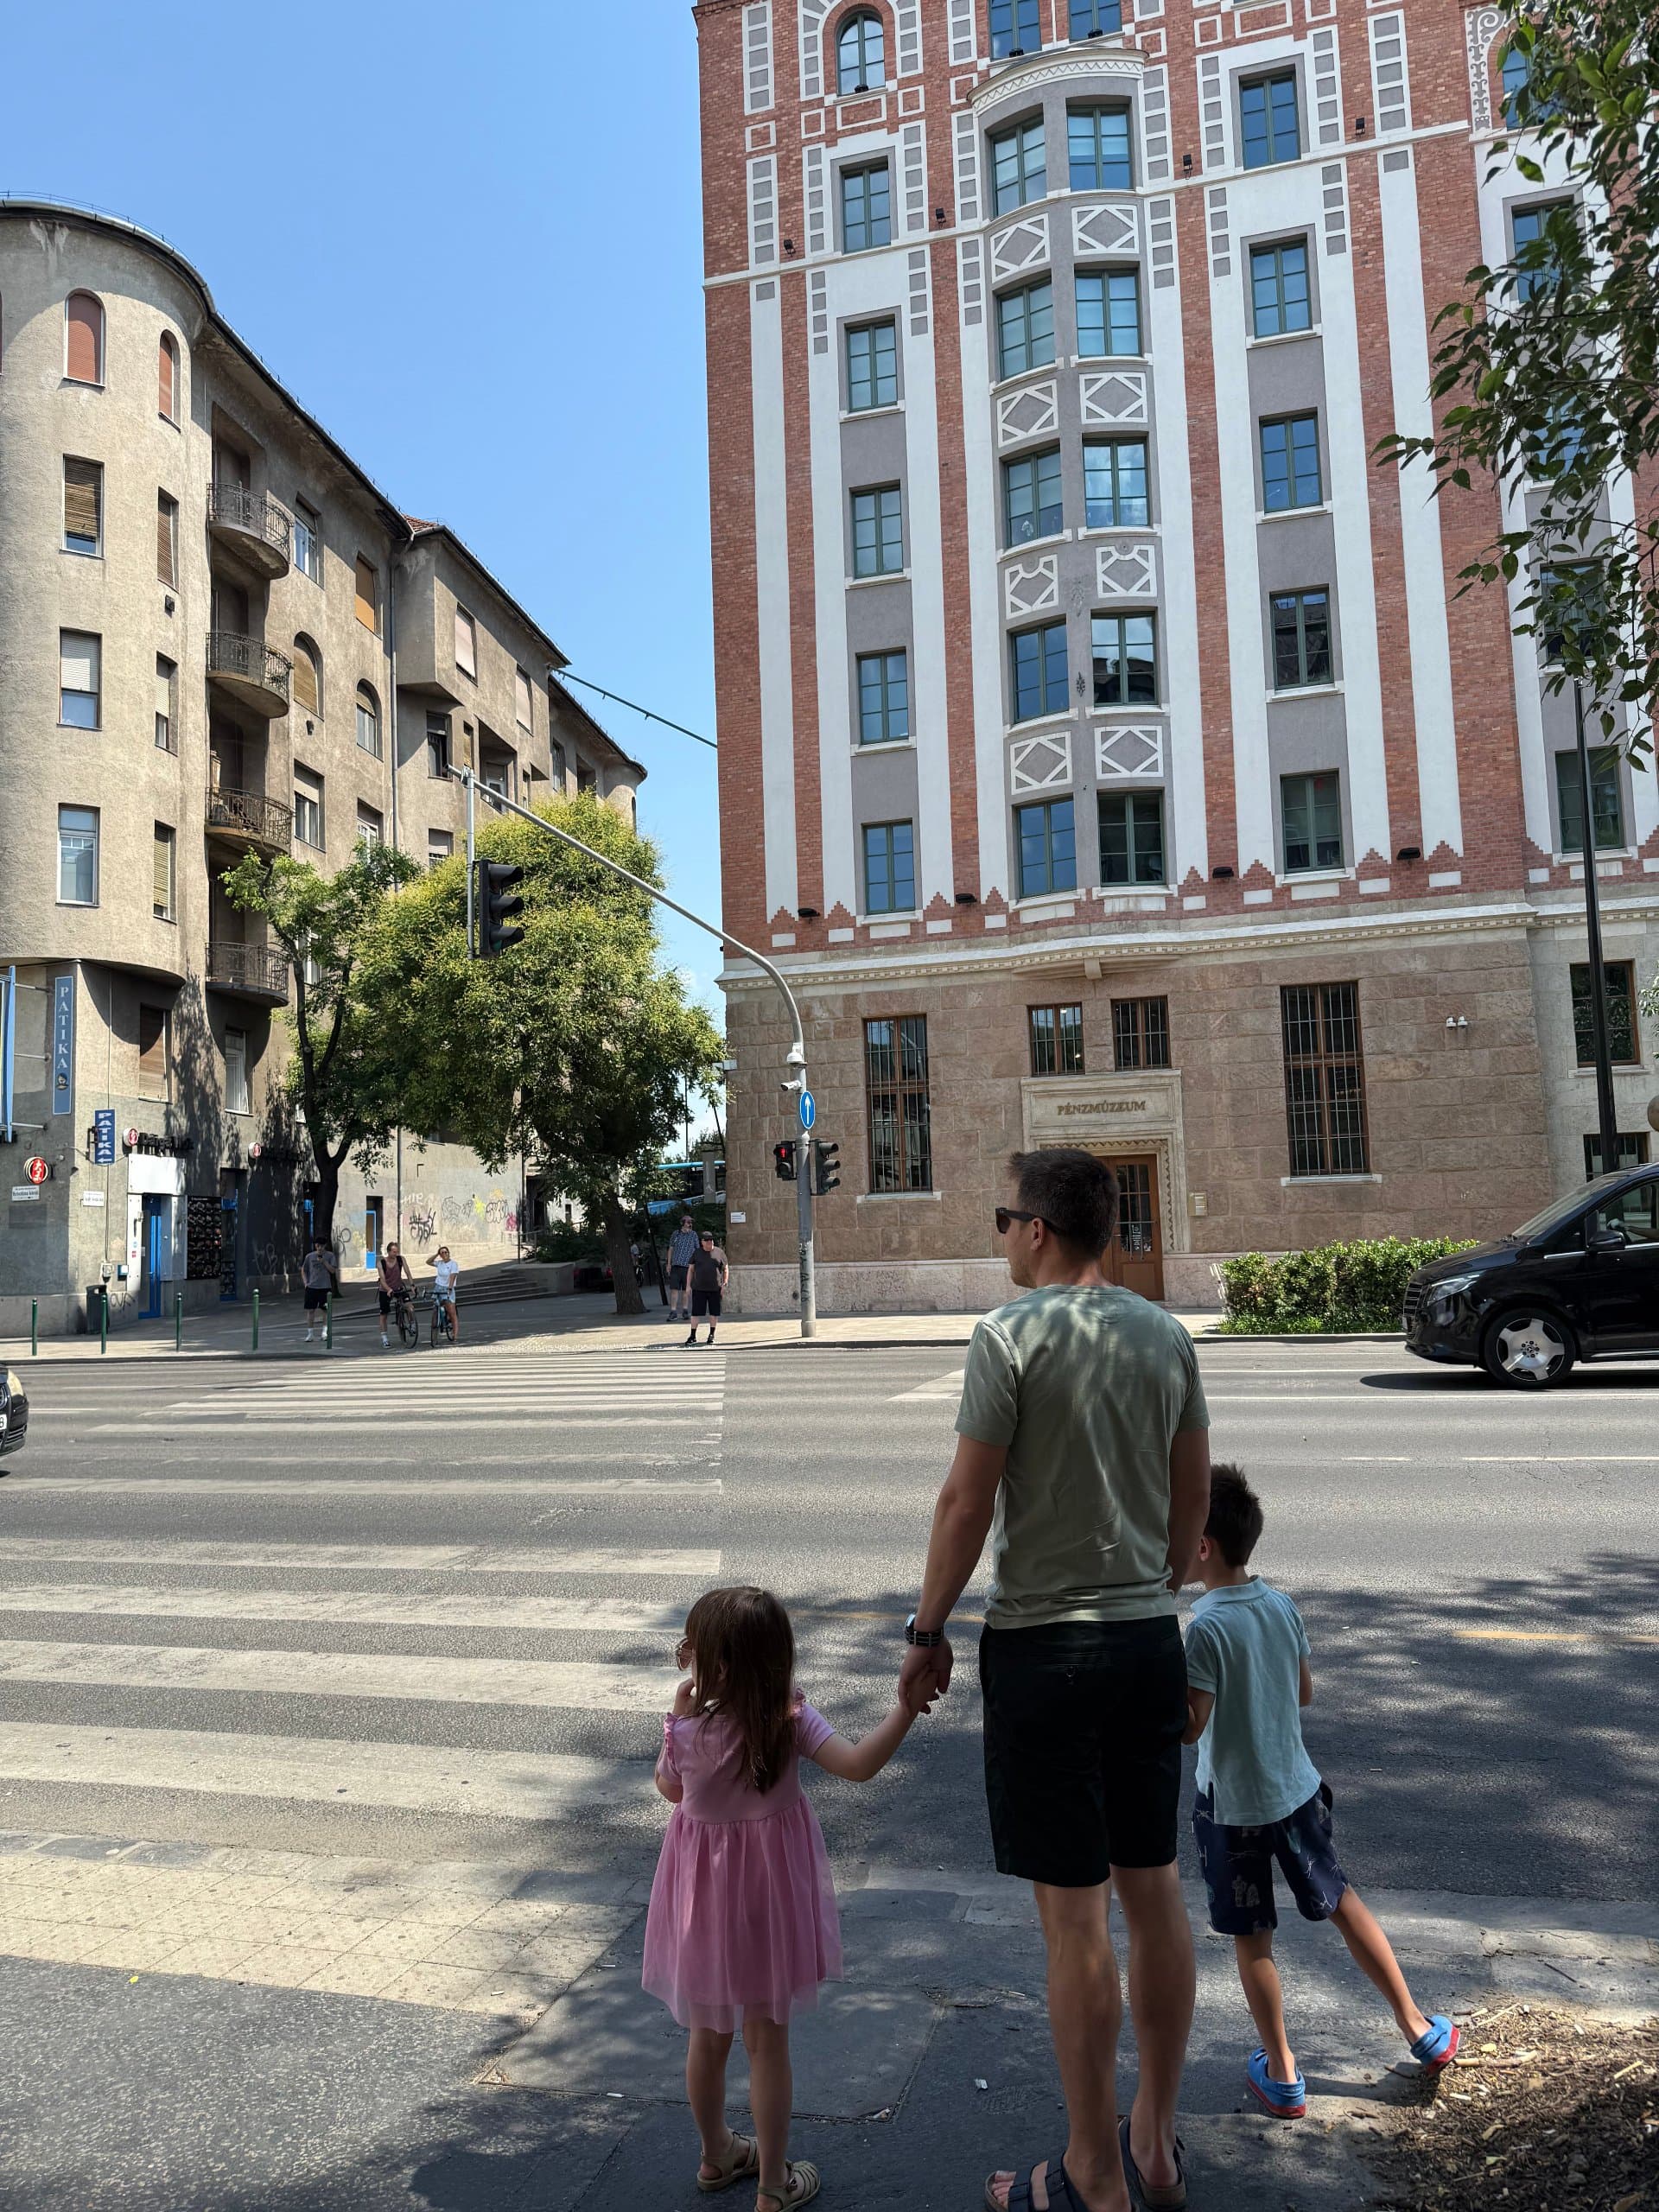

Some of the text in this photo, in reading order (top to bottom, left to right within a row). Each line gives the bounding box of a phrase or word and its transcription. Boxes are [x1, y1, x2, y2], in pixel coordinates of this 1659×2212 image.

[57, 987, 69, 1069] PATIKA
[1057, 1100, 1147, 1116] PÉNZMÚZEUM
[97, 1112, 112, 1155] PATIKA
